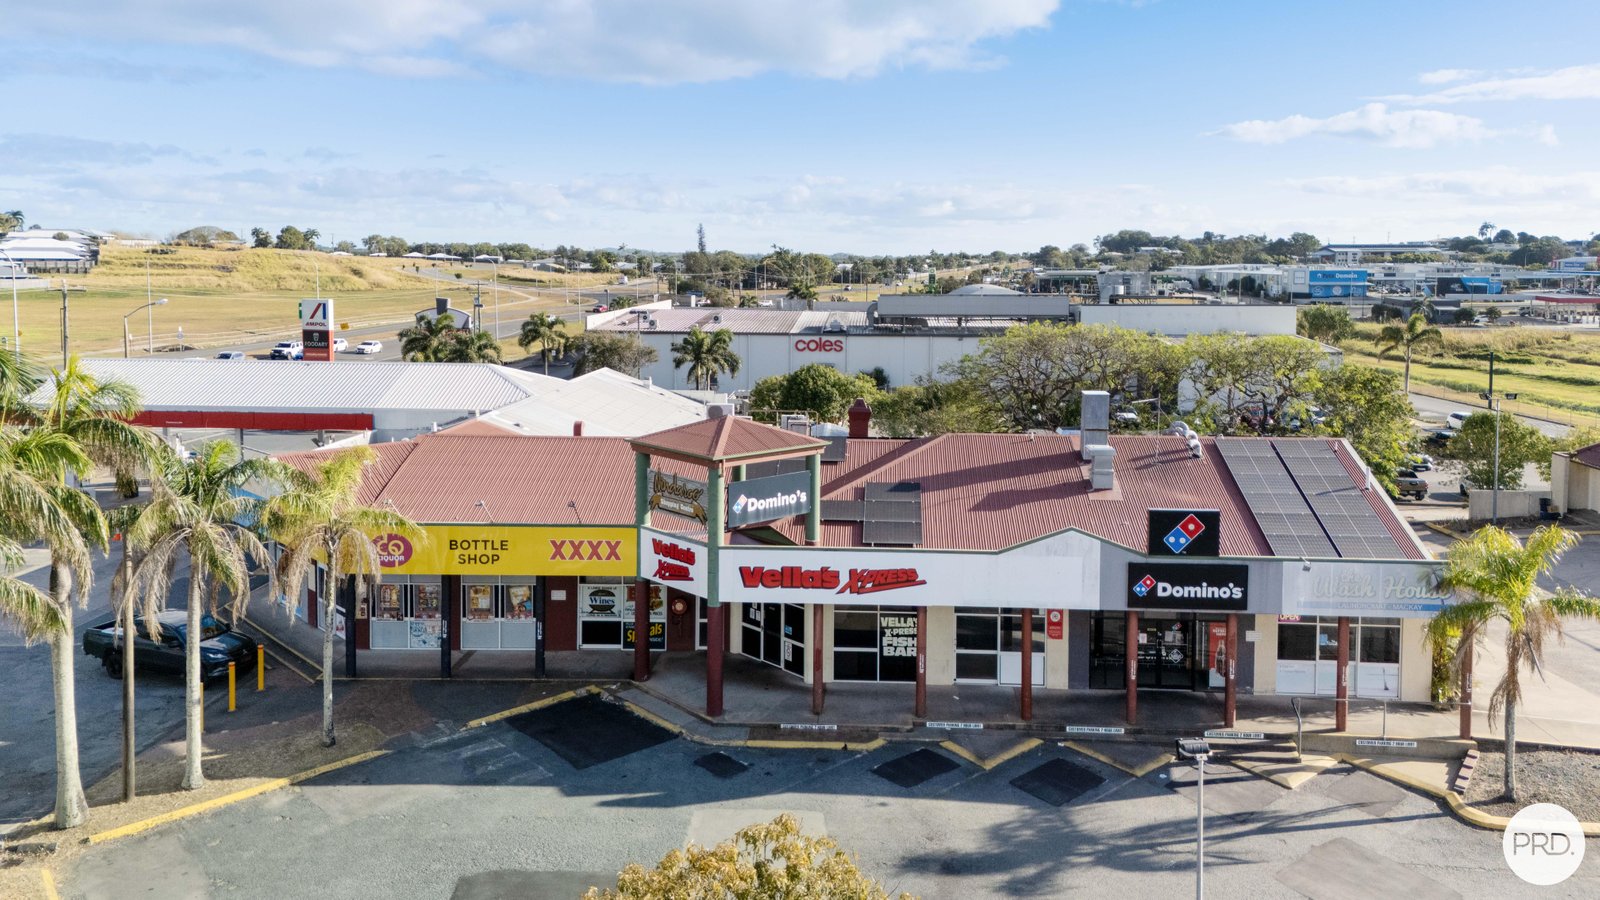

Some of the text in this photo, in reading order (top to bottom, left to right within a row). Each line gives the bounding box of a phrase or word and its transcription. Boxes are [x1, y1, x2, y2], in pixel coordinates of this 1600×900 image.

[794, 336, 844, 352] coles
[747, 489, 807, 512] Domino's
[449, 540, 509, 551] BOTTLE
[549, 539, 622, 561] XXXX
[458, 554, 500, 565] SHOP
[739, 566, 840, 589] Vella's
[1157, 582, 1243, 599] Domino's
[1313, 574, 1376, 599] Wash
[589, 596, 615, 605] Wines
[882, 636, 917, 648] FISH
[882, 647, 917, 657] BAR
